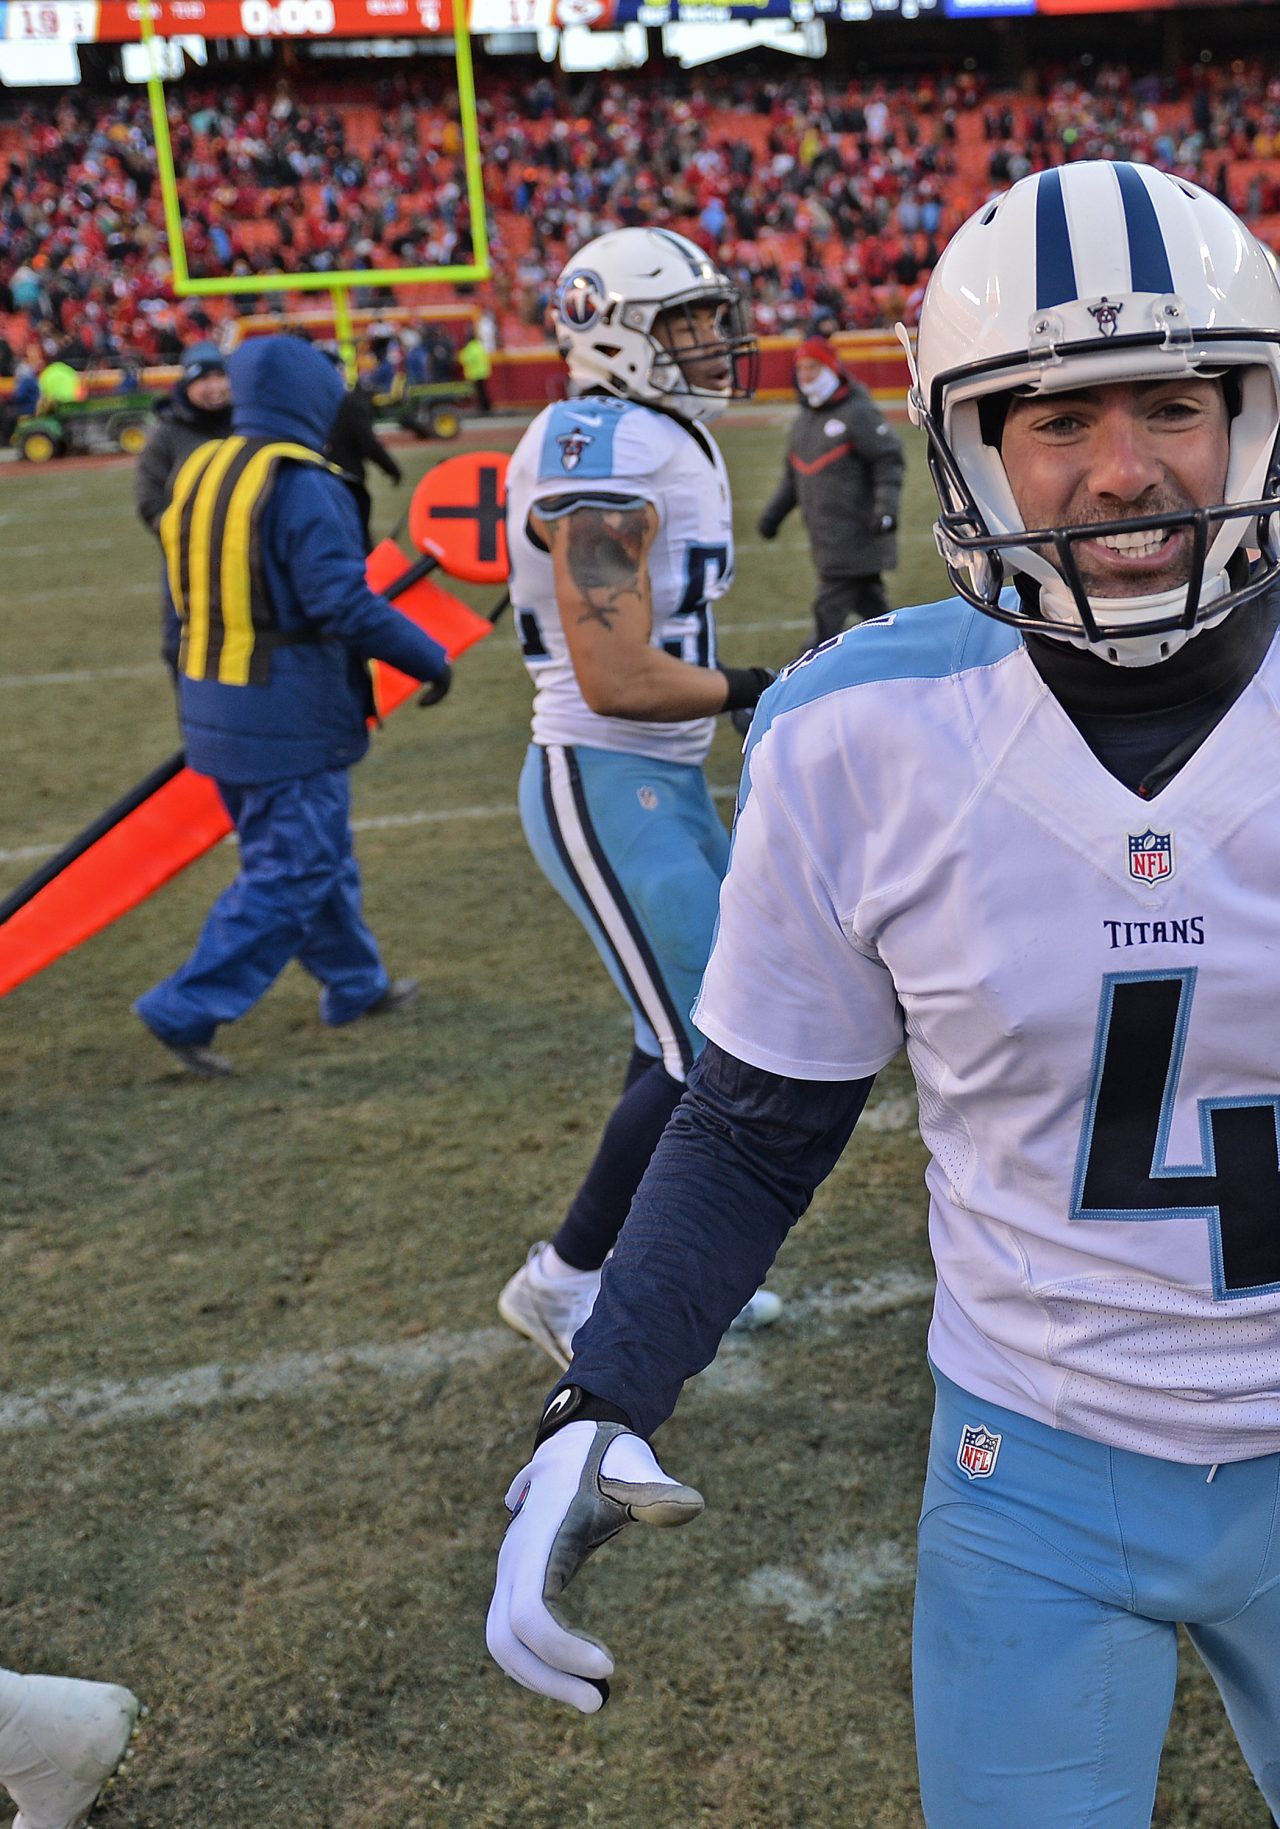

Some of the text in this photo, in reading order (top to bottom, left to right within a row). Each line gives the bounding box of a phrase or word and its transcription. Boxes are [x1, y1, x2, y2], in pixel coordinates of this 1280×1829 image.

[240, 0, 336, 35] 0:00
[1133, 852, 1168, 878] NFL
[1103, 916, 1205, 949] TITANS
[962, 1445, 989, 1472] NFL
